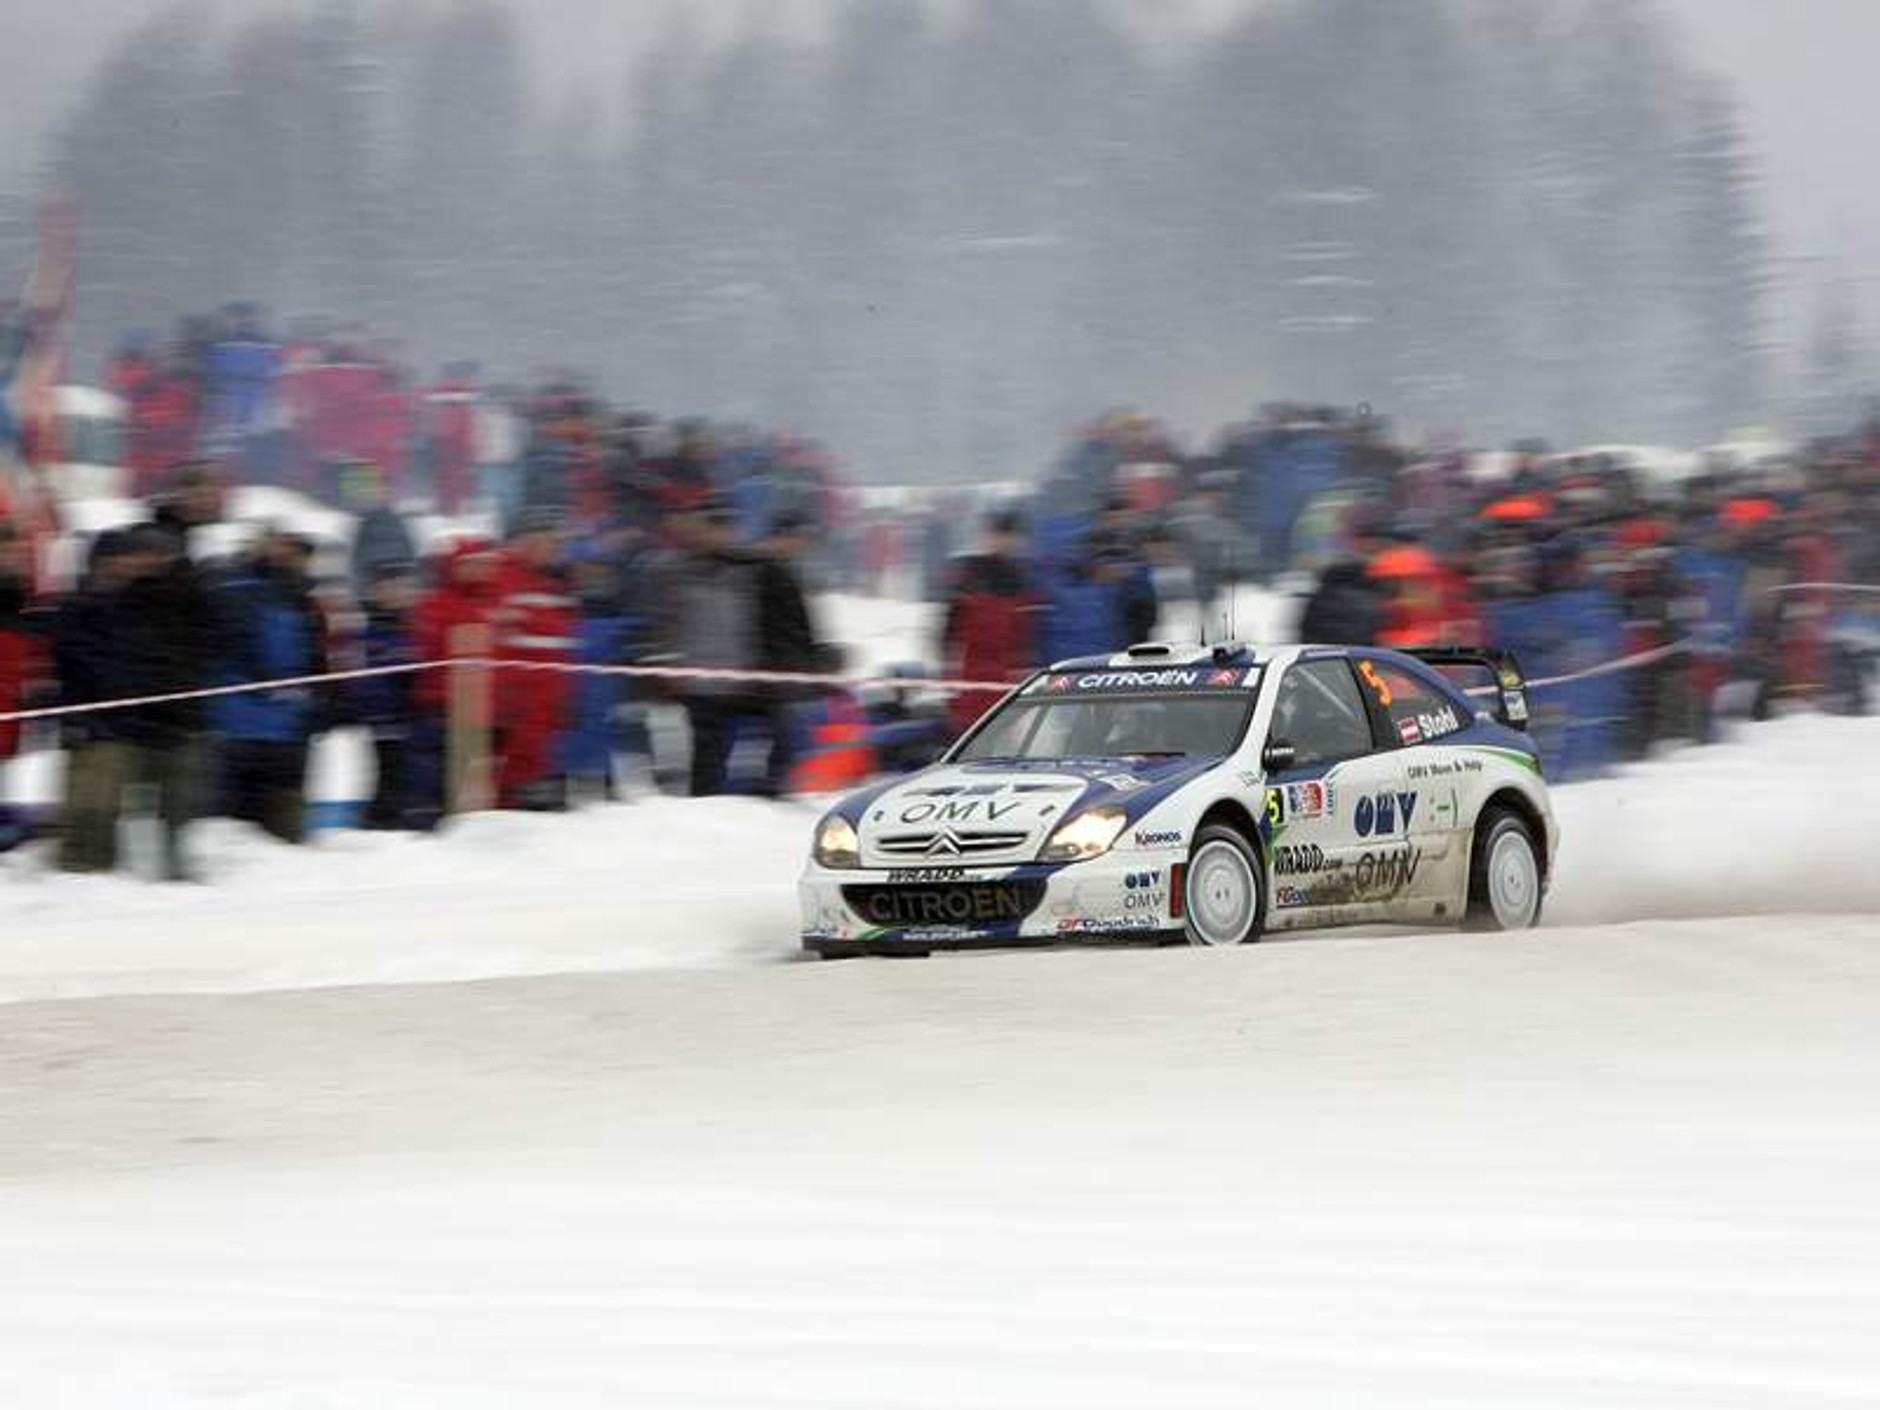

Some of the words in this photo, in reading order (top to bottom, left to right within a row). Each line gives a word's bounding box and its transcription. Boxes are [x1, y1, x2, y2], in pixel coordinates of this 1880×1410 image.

[1359, 659, 1391, 706] 5
[1418, 704, 1459, 738] Stohl
[901, 800, 1020, 823] OMV
[1265, 788, 1281, 825] 5
[1356, 848, 1422, 889] OMV
[1124, 893, 1163, 909] OMV
